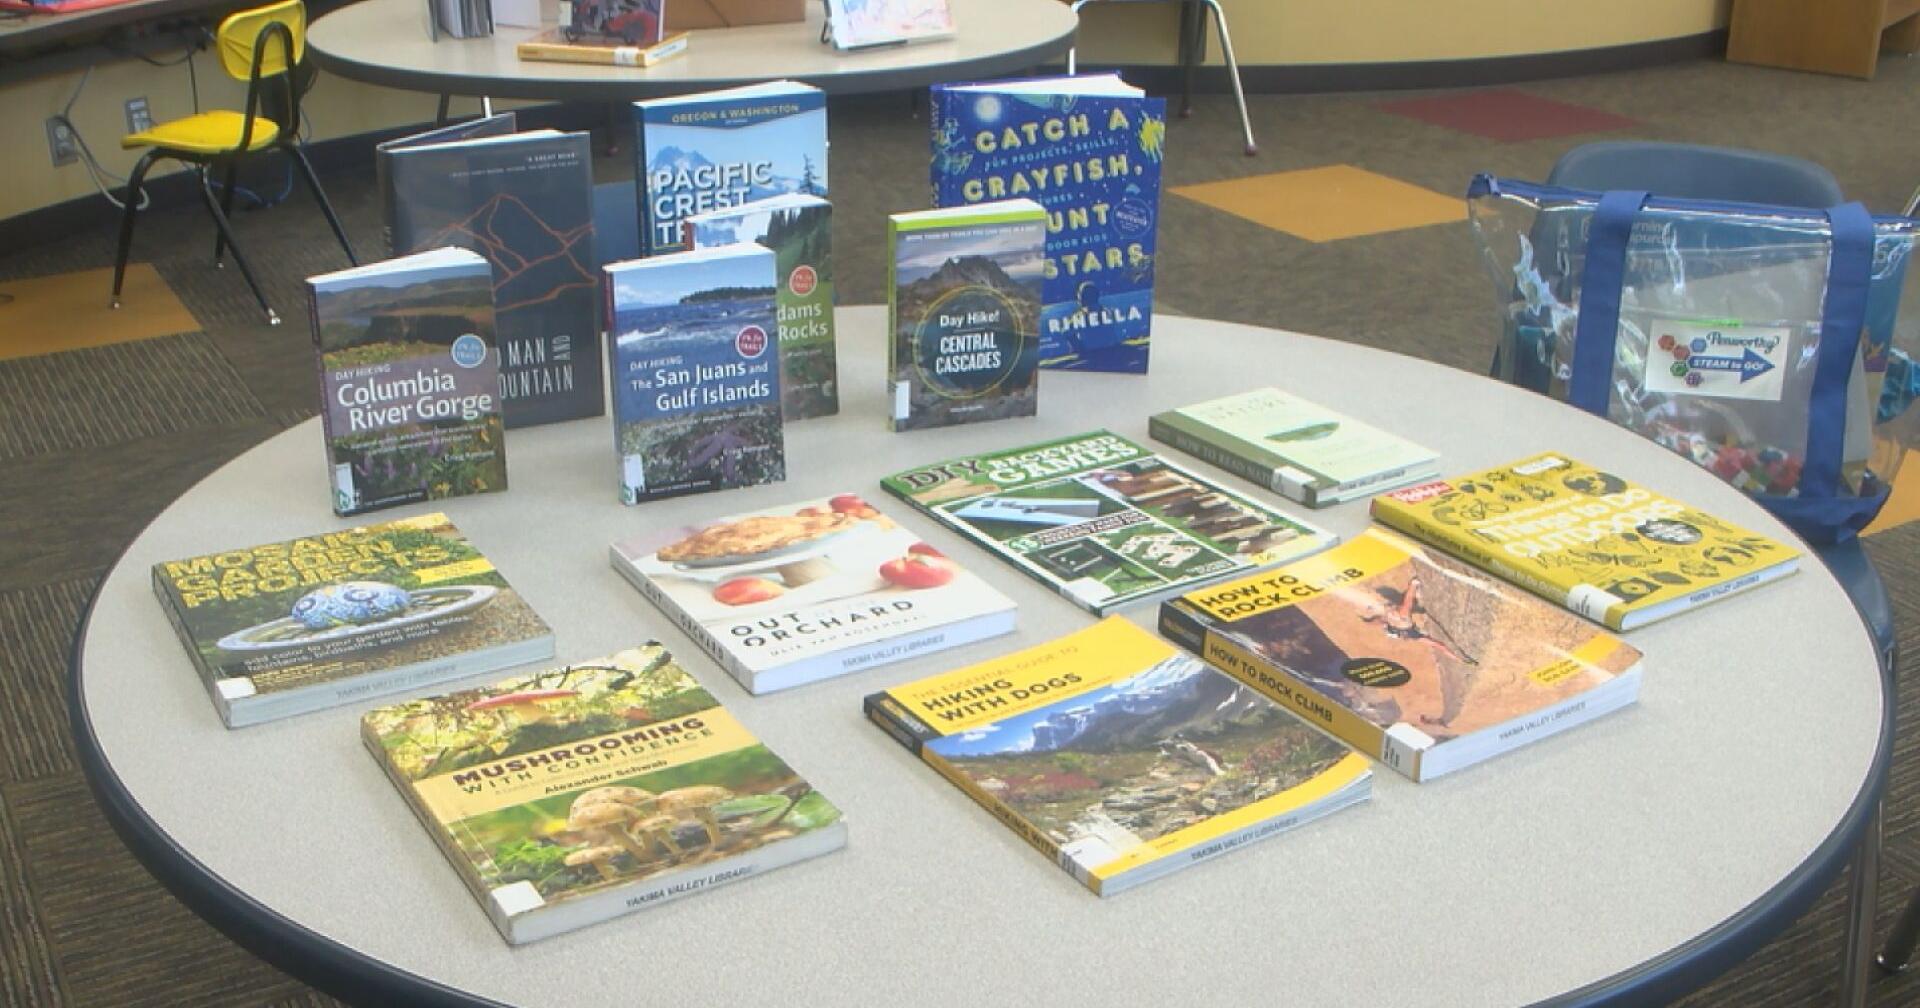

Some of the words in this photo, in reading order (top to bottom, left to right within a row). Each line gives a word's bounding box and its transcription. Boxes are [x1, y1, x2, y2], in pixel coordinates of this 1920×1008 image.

[672, 112, 716, 123] OREGON
[729, 104, 799, 118] WASHINGTON
[976, 113, 1089, 153] CATCH
[1108, 107, 1130, 131] A
[656, 160, 773, 195] PACIFIC
[962, 153, 1143, 201] CRAYFISH,
[655, 187, 750, 219] CREST
[1045, 202, 1110, 234] UNT
[777, 303, 822, 322] dams
[940, 314, 965, 328] Day
[778, 320, 828, 342] Rocks
[940, 331, 997, 354] CENTRAL
[507, 336, 545, 367] MAN
[630, 361, 648, 372] DAY
[650, 355, 683, 369] HIKING
[936, 352, 1001, 375] CASCADES
[1693, 359, 1730, 369] STEAM
[336, 369, 353, 381] DAY
[355, 363, 392, 378] HIKING
[337, 367, 456, 408] Columbia
[497, 364, 573, 399] OUNTAIN
[631, 380, 653, 391] The
[655, 369, 691, 388] San
[695, 361, 747, 385] Juans
[750, 361, 768, 374] and
[656, 387, 700, 412] Gulf
[703, 379, 771, 405] Islands
[350, 403, 413, 432] River
[416, 394, 492, 421] Gorge
[900, 459, 984, 490] DIY
[988, 440, 1139, 484] GAMES
[1201, 585, 1260, 607] HOW
[1263, 574, 1299, 588] TO
[1219, 593, 1288, 617] ROCK
[307, 644, 321, 652] to
[324, 639, 352, 652] your
[356, 629, 400, 645] garden
[403, 621, 431, 634] with
[731, 611, 801, 637] OUT
[743, 600, 914, 647] ORCHARD
[380, 635, 404, 646] and
[871, 646, 902, 662] VALLEY
[904, 634, 946, 652] LIBRARIES
[922, 677, 1014, 711] HIKING
[936, 695, 1009, 722] WITH
[1011, 671, 1083, 701] DOGS
[1210, 643, 1239, 667] HOW
[1240, 661, 1257, 679] TO
[1258, 673, 1292, 700] ROCK
[1294, 692, 1333, 723] CLIMB
[453, 717, 704, 786] MUSHROOMING
[463, 770, 533, 795] WITH
[547, 728, 714, 774] CONFIDENCE
[544, 773, 612, 795] Alexander
[615, 759, 669, 776] Schwab
[626, 889, 665, 907] YAKIMA
[668, 879, 705, 895] VALLEY
